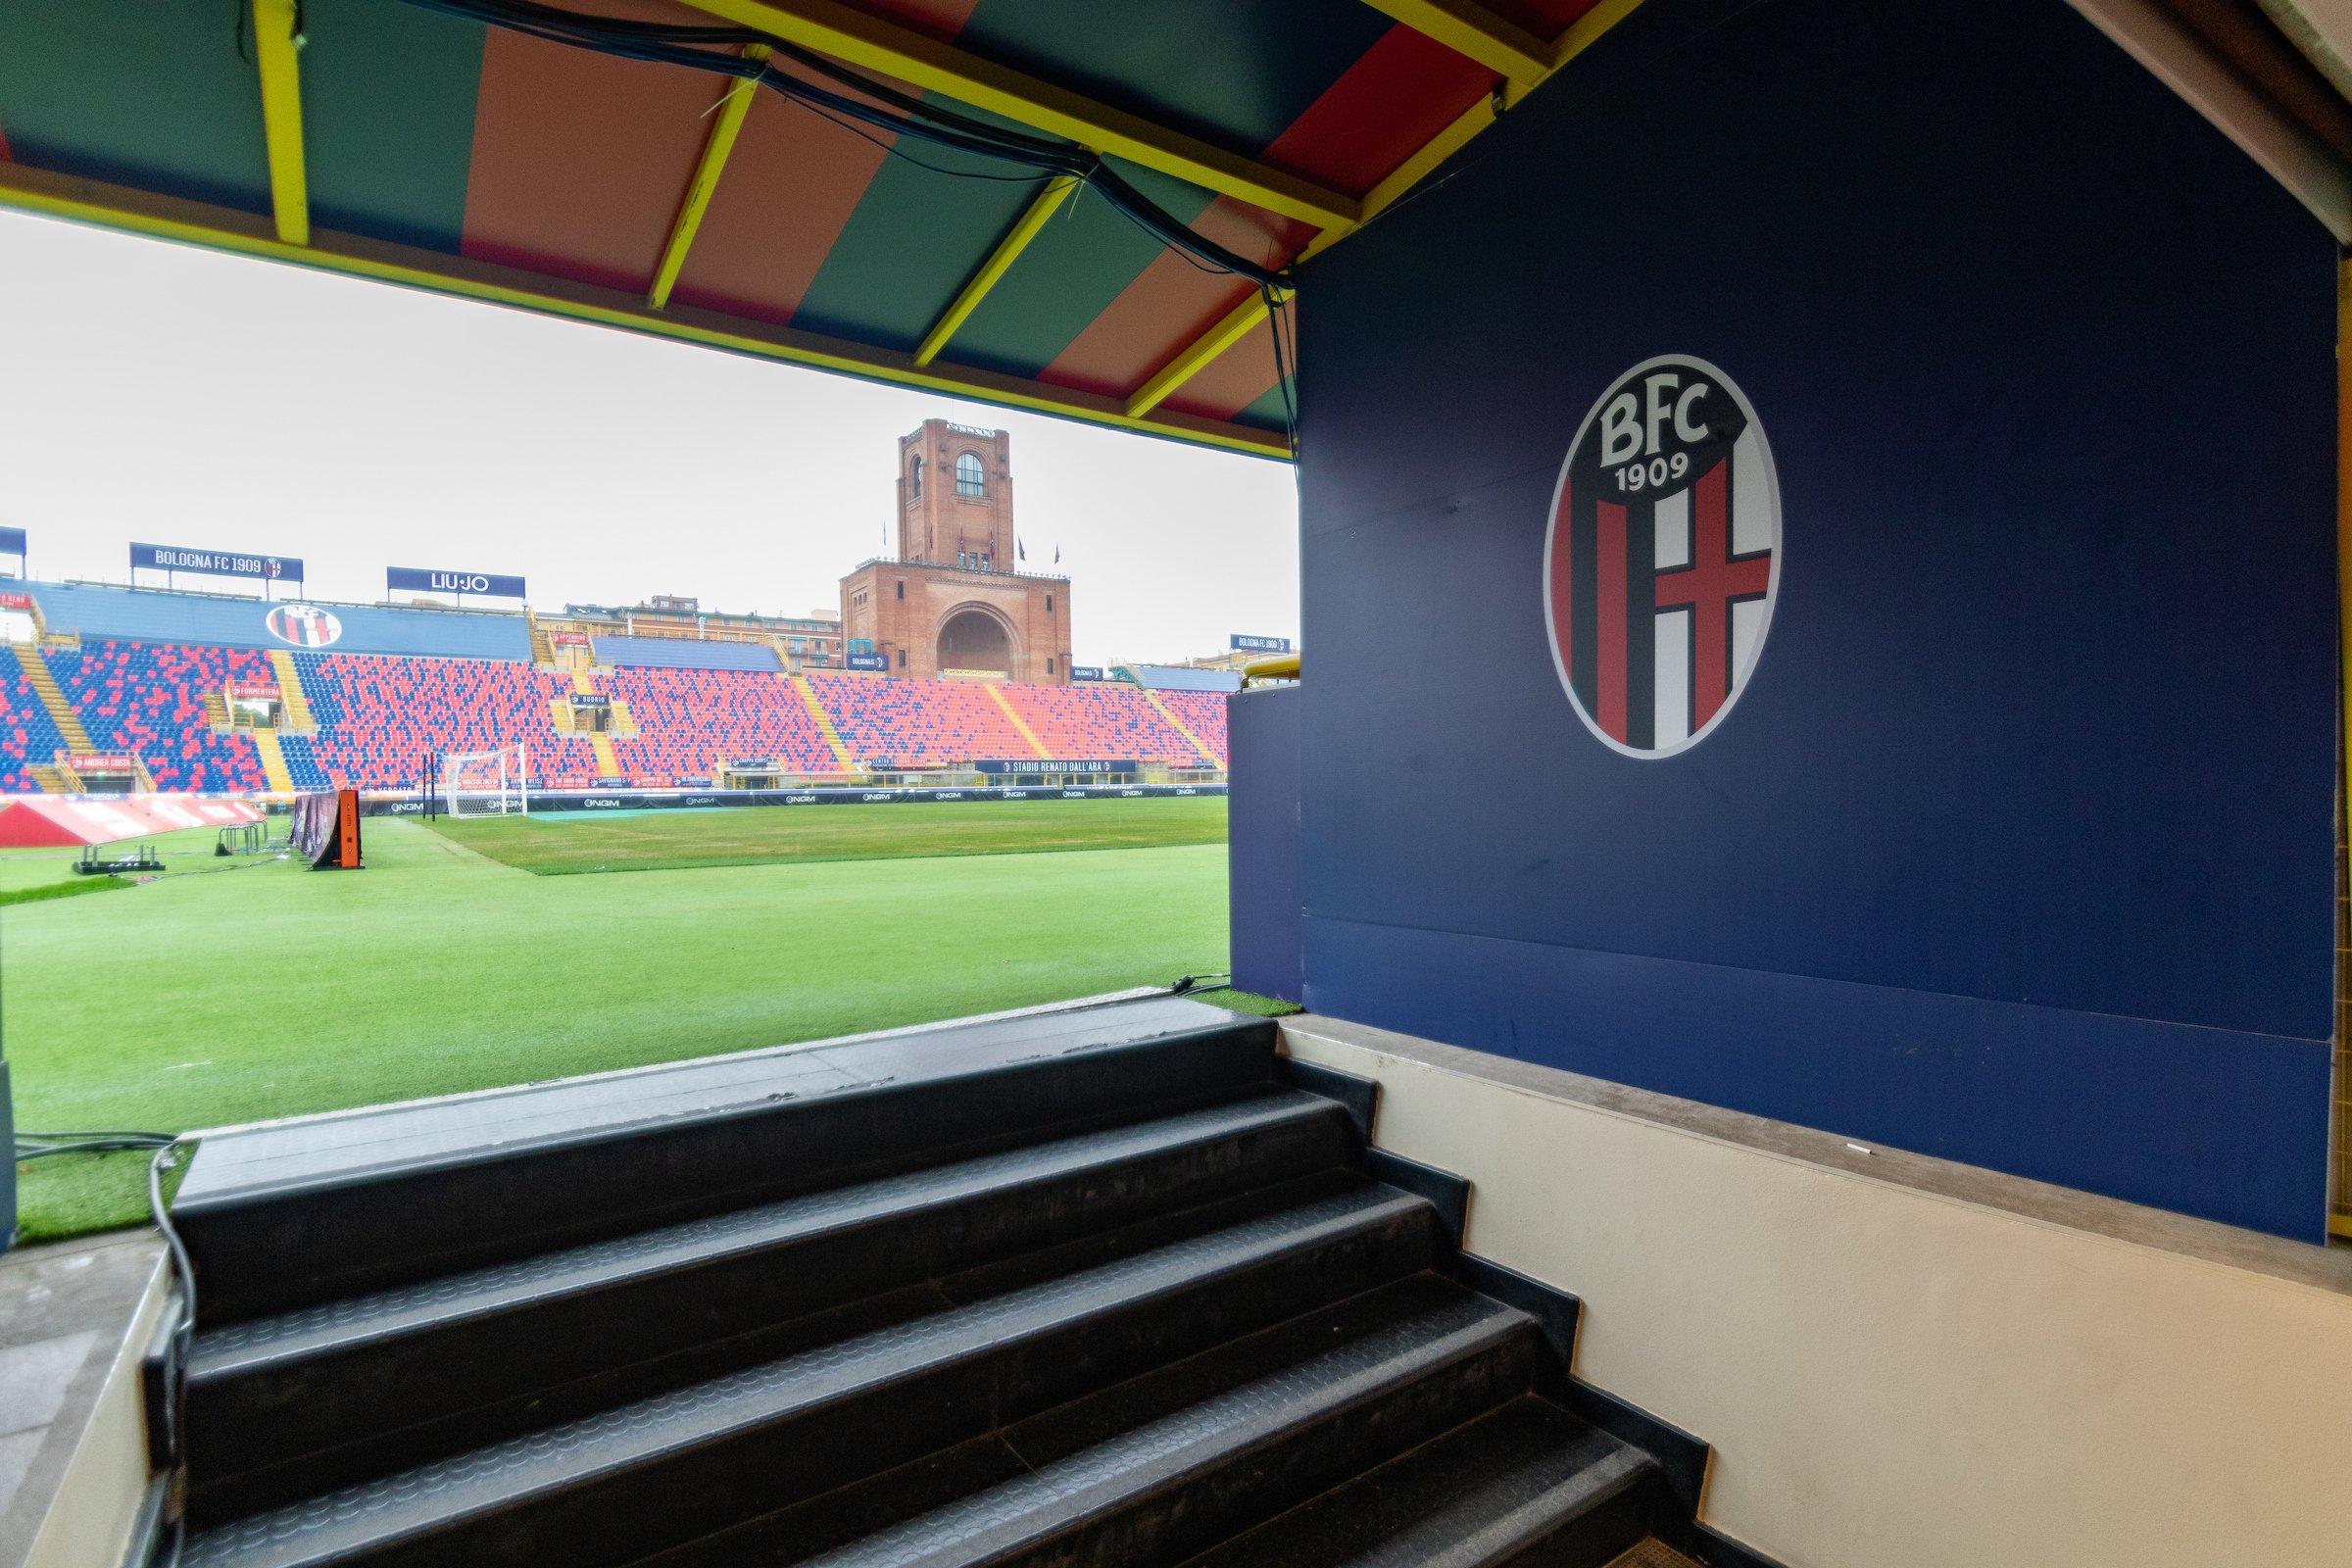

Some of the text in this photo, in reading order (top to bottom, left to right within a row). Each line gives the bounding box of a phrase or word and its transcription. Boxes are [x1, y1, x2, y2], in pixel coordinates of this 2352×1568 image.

[1599, 373, 1709, 468] BFC
[1615, 452, 1690, 491] 1909
[155, 549, 213, 569] BOLOGNA
[214, 556, 229, 570] FC
[231, 557, 262, 573] 1909
[1238, 637, 1259, 647] BOLOGNA
[1259, 639, 1266, 648] FC
[240, 687, 279, 696] FORMENTERA
[83, 758, 131, 767] ANDREA COSTA
[1013, 761, 1102, 772] STADIO RENATO DALL'ARA
